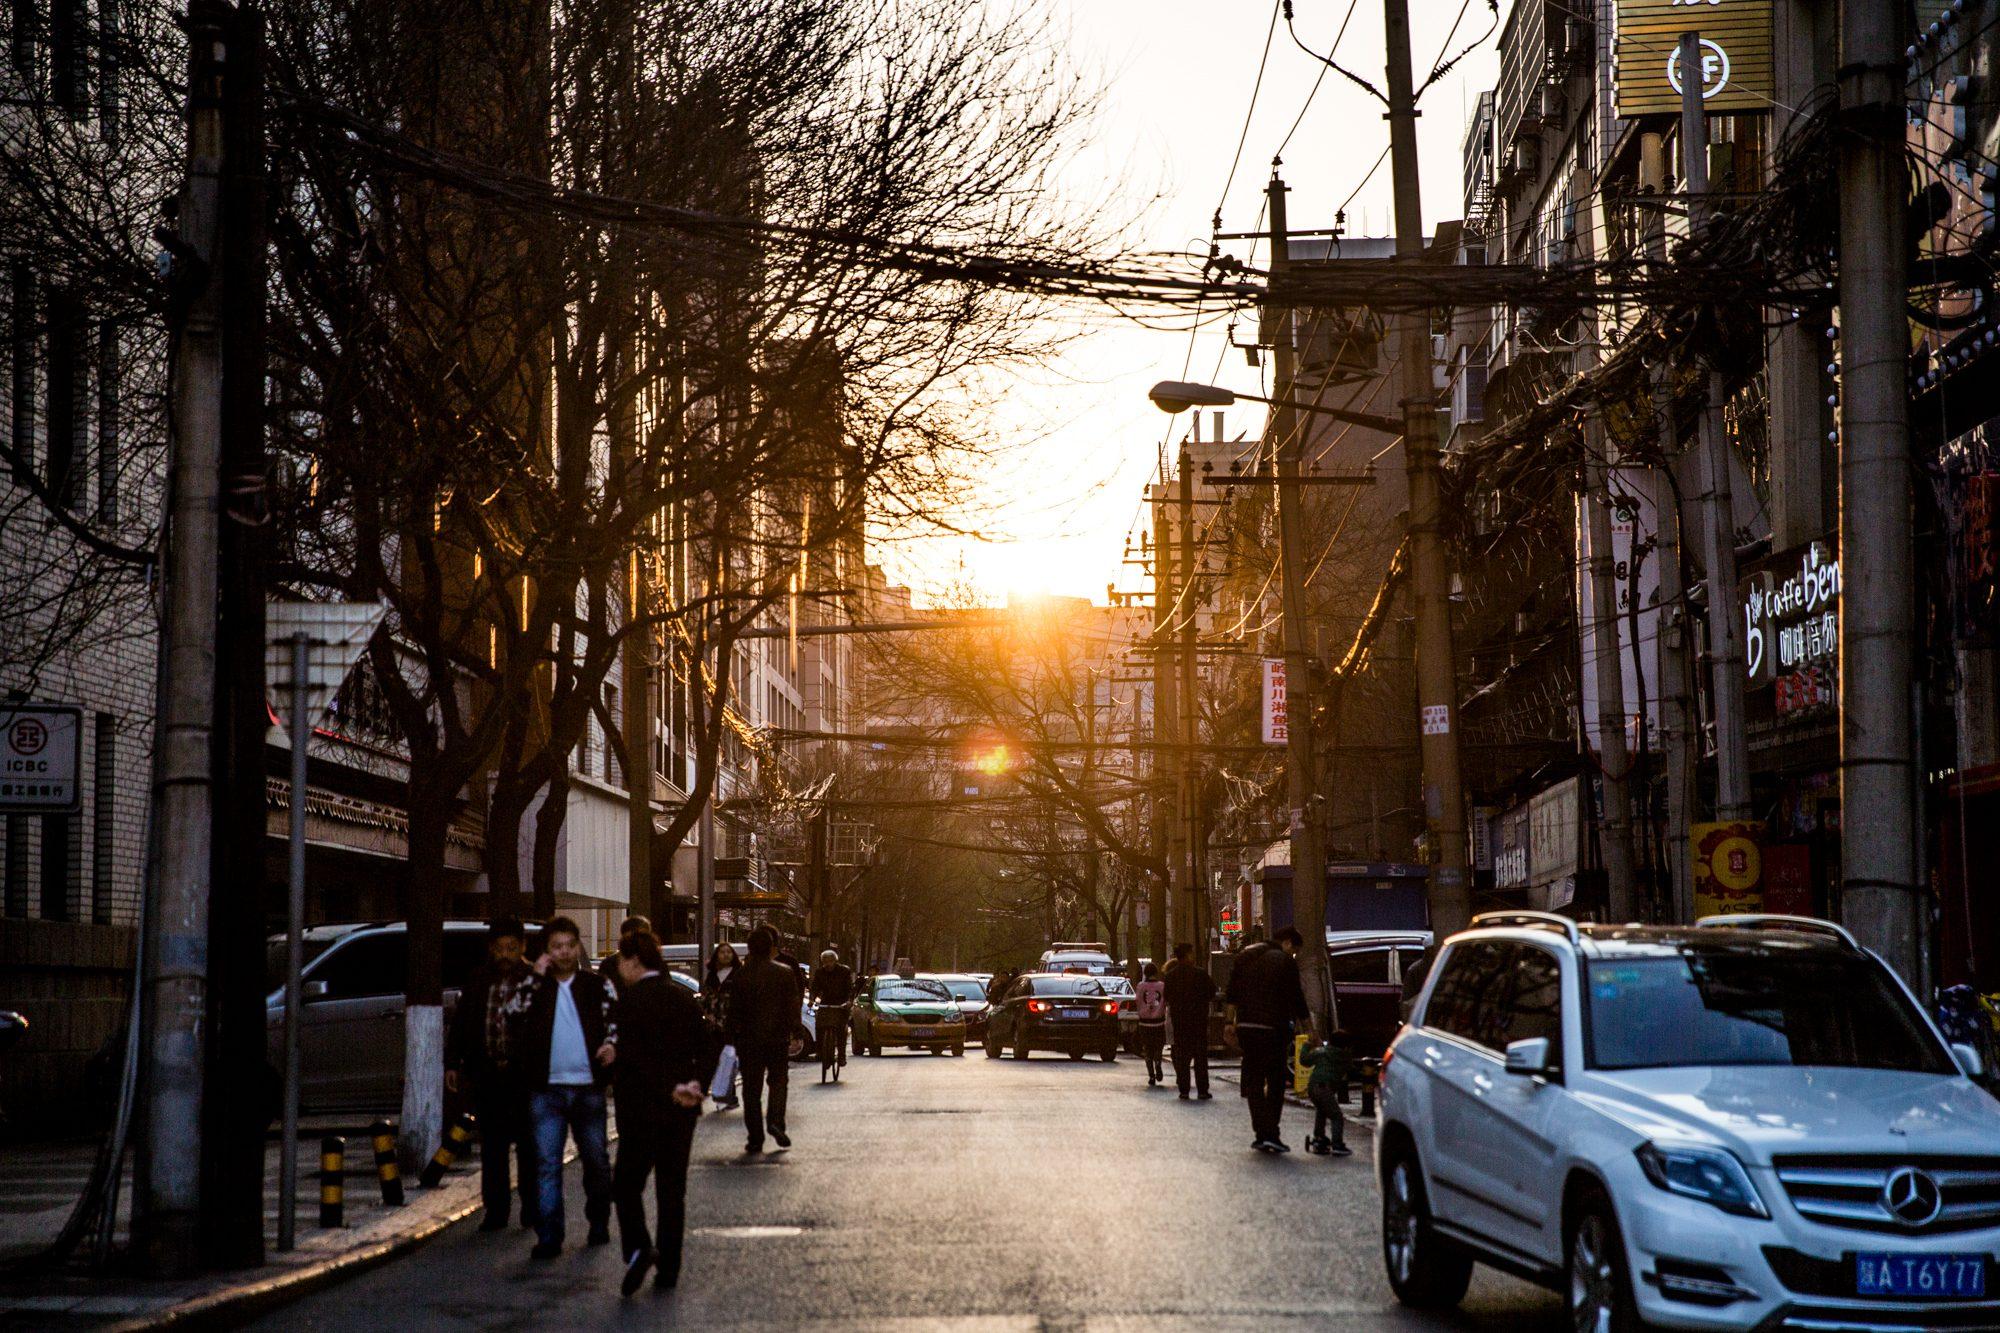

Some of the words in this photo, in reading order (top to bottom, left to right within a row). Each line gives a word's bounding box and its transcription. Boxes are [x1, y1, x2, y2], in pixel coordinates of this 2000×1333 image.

[1780, 612, 1836, 666] 咖啡陪你
[7, 760, 48, 772] ICBC
